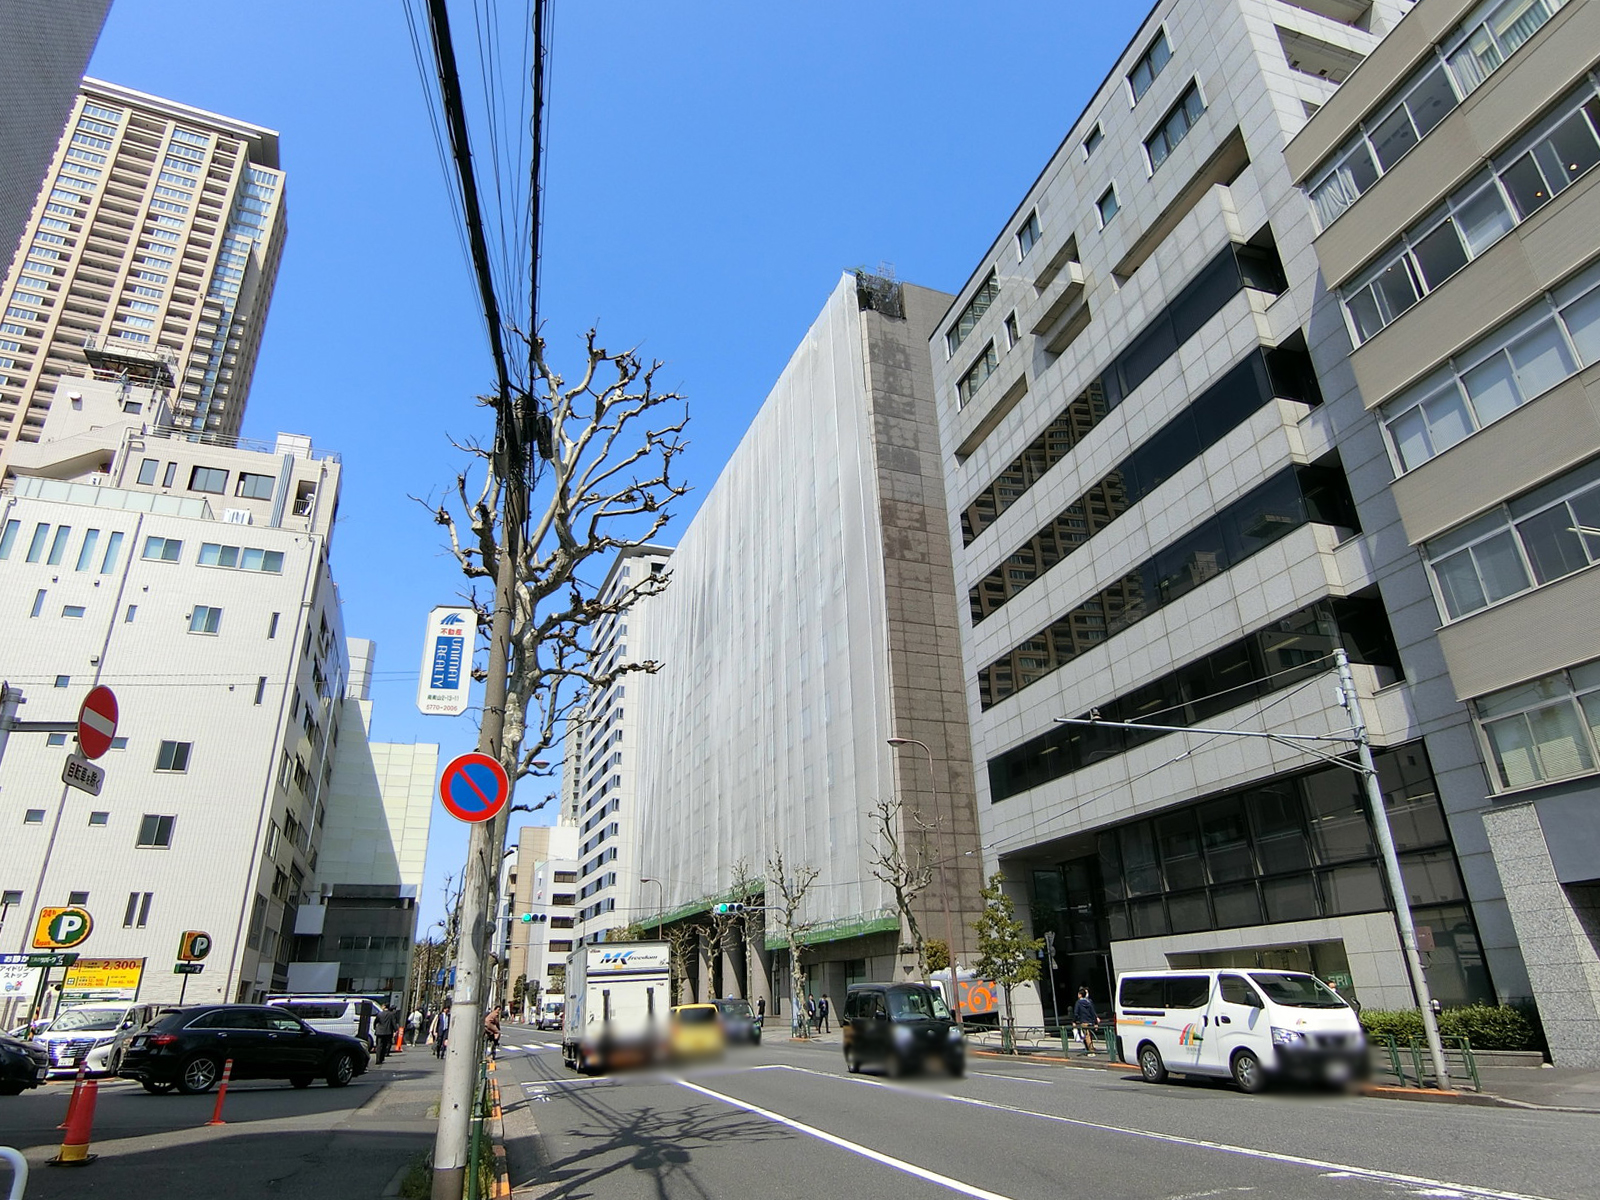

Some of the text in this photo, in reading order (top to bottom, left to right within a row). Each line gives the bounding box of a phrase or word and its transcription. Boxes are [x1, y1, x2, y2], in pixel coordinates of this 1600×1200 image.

[441, 628, 463, 636] 不動産
[433, 645, 448, 688] REALTY
[448, 638, 463, 682] UNIMAT
[67, 762, 101, 789] 自転車を除く
[57, 915, 83, 940] P
[194, 937, 209, 956] P
[600, 951, 635, 964] MK
